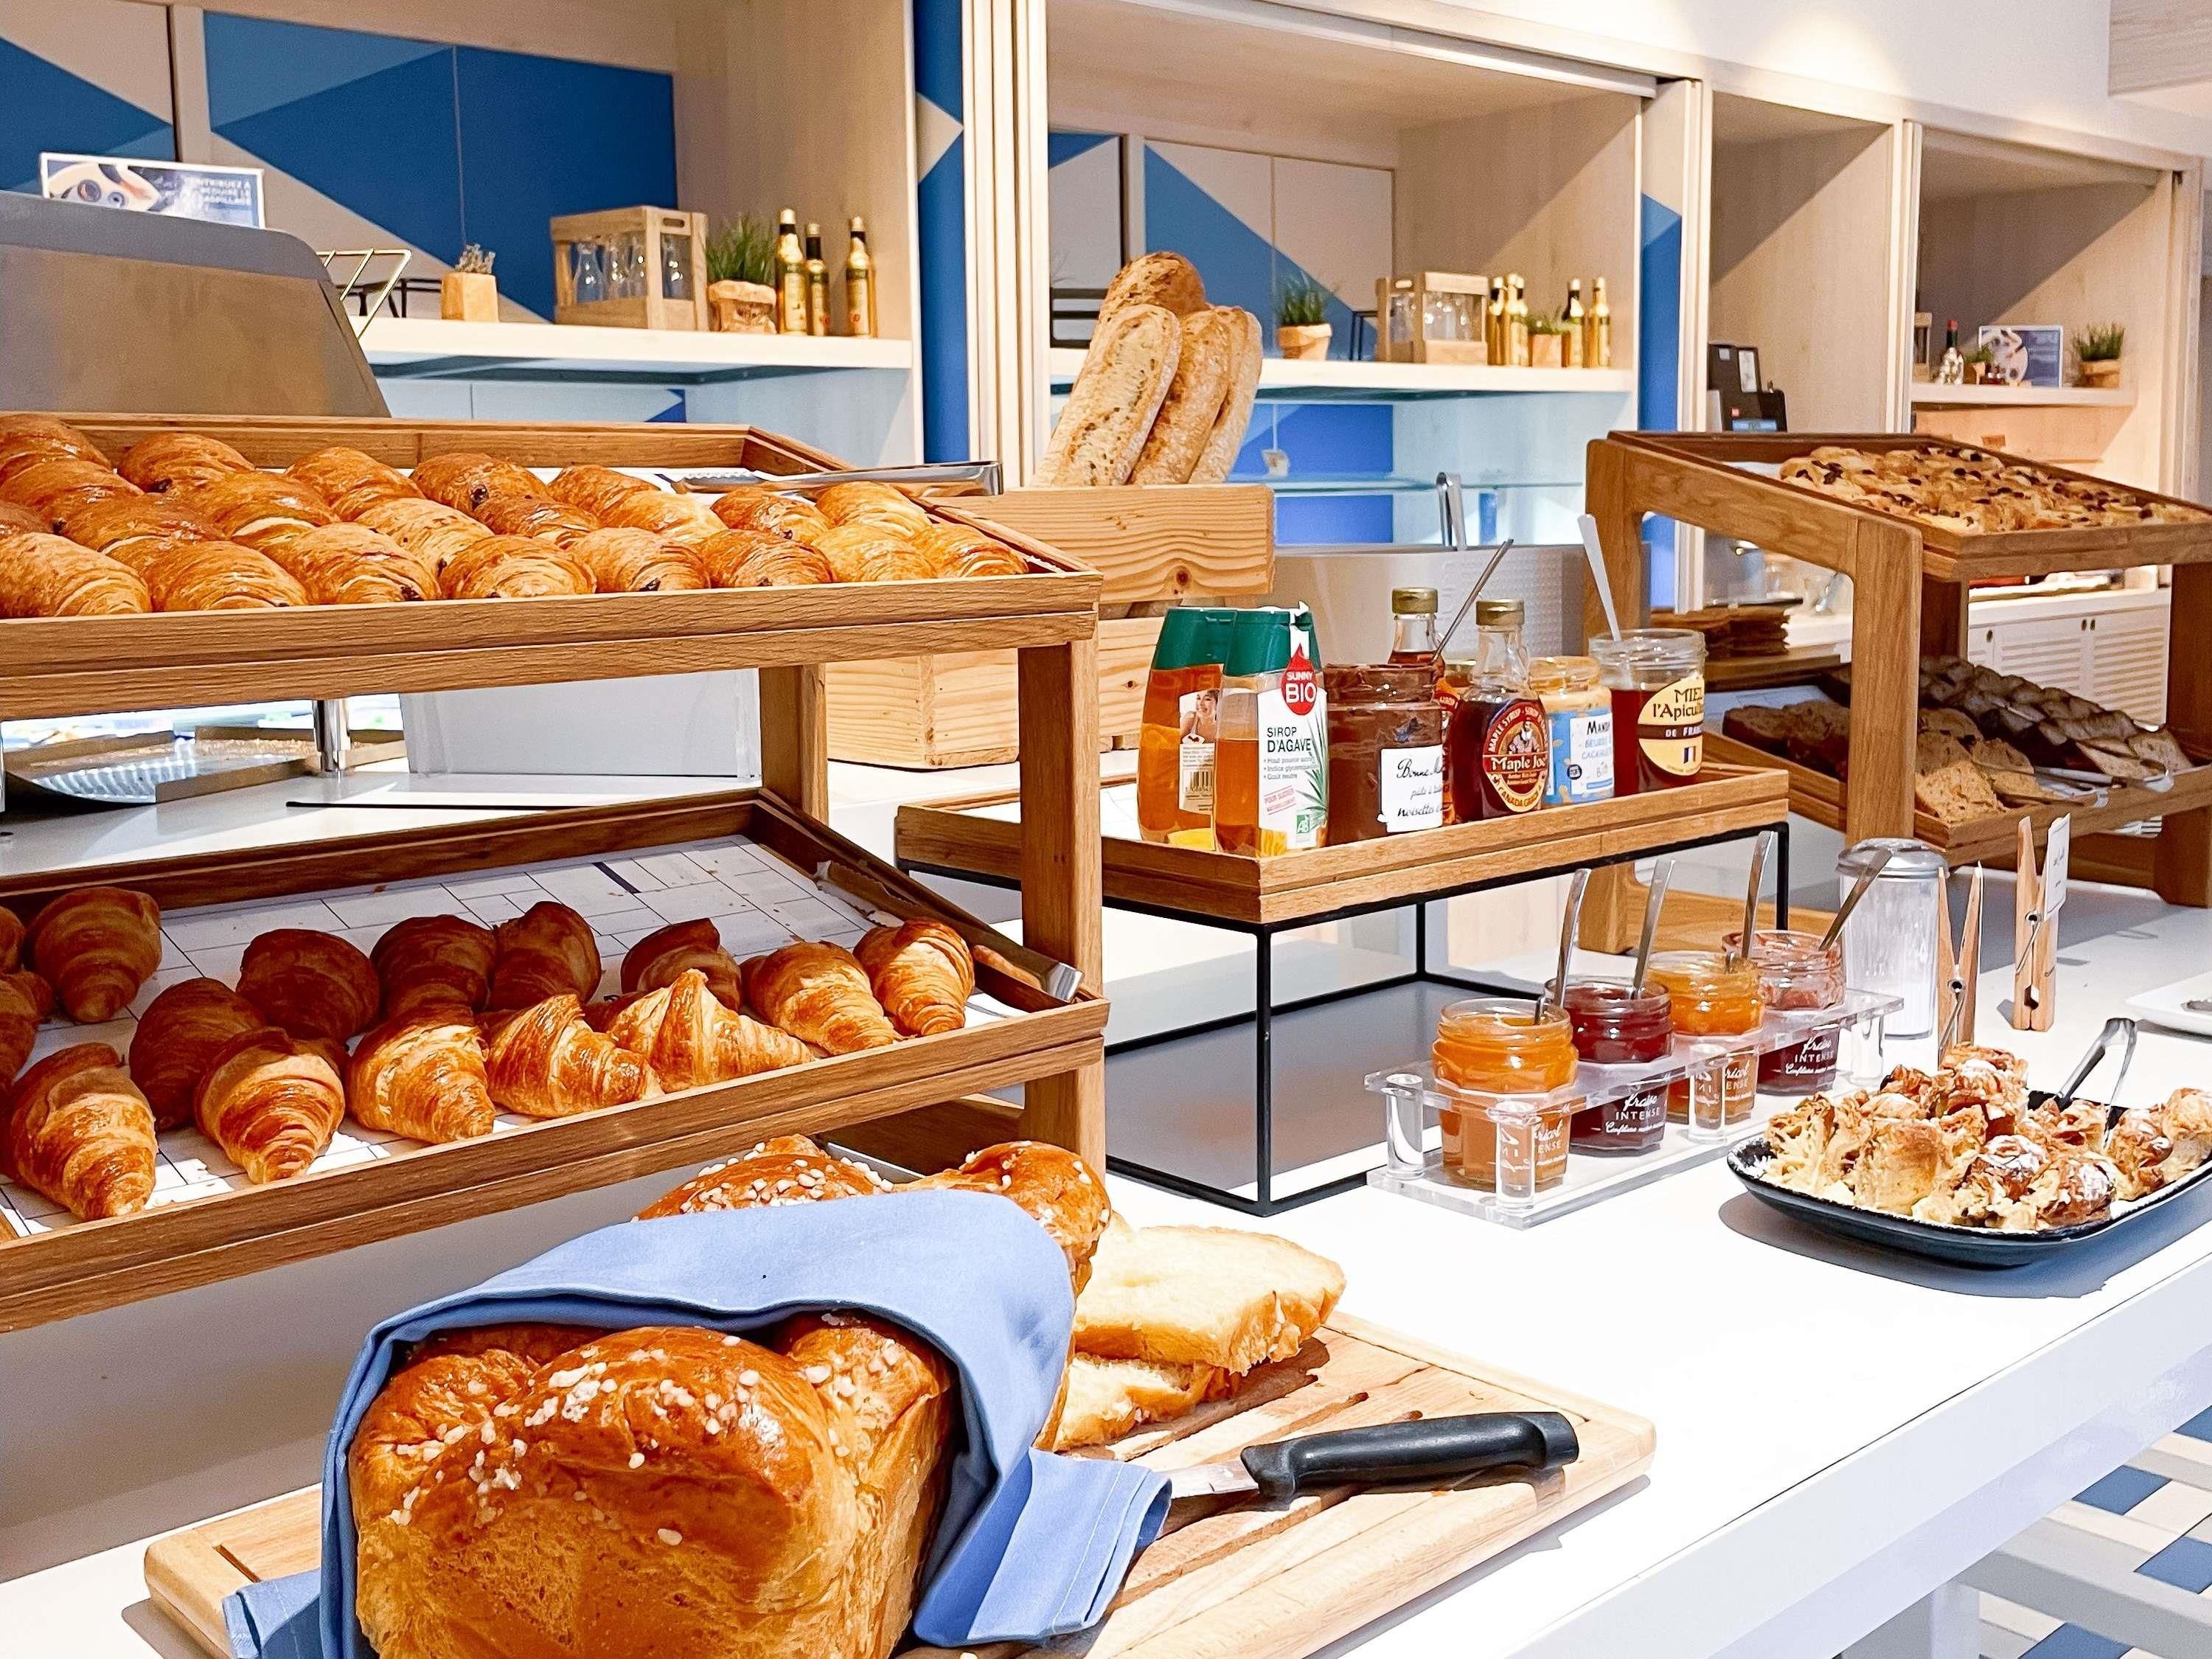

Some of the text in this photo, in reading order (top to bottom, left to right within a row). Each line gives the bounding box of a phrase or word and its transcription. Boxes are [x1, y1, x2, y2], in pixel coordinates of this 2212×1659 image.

[1287, 672, 1313, 681] SUNNY
[1285, 682, 1317, 703] BIO
[1267, 727, 1297, 738] SIROP
[1488, 725, 1505, 752] MAPLE
[1665, 728, 1677, 737] DE
[1267, 738, 1312, 753] D'AGAVE
[1397, 757, 1429, 779] Bonne
[1491, 755, 1547, 773] Maple Joe
[1298, 818, 1310, 833] AB
[1794, 1051, 1834, 1062] INTENSE
[1615, 1107, 1660, 1121] INTENSE
